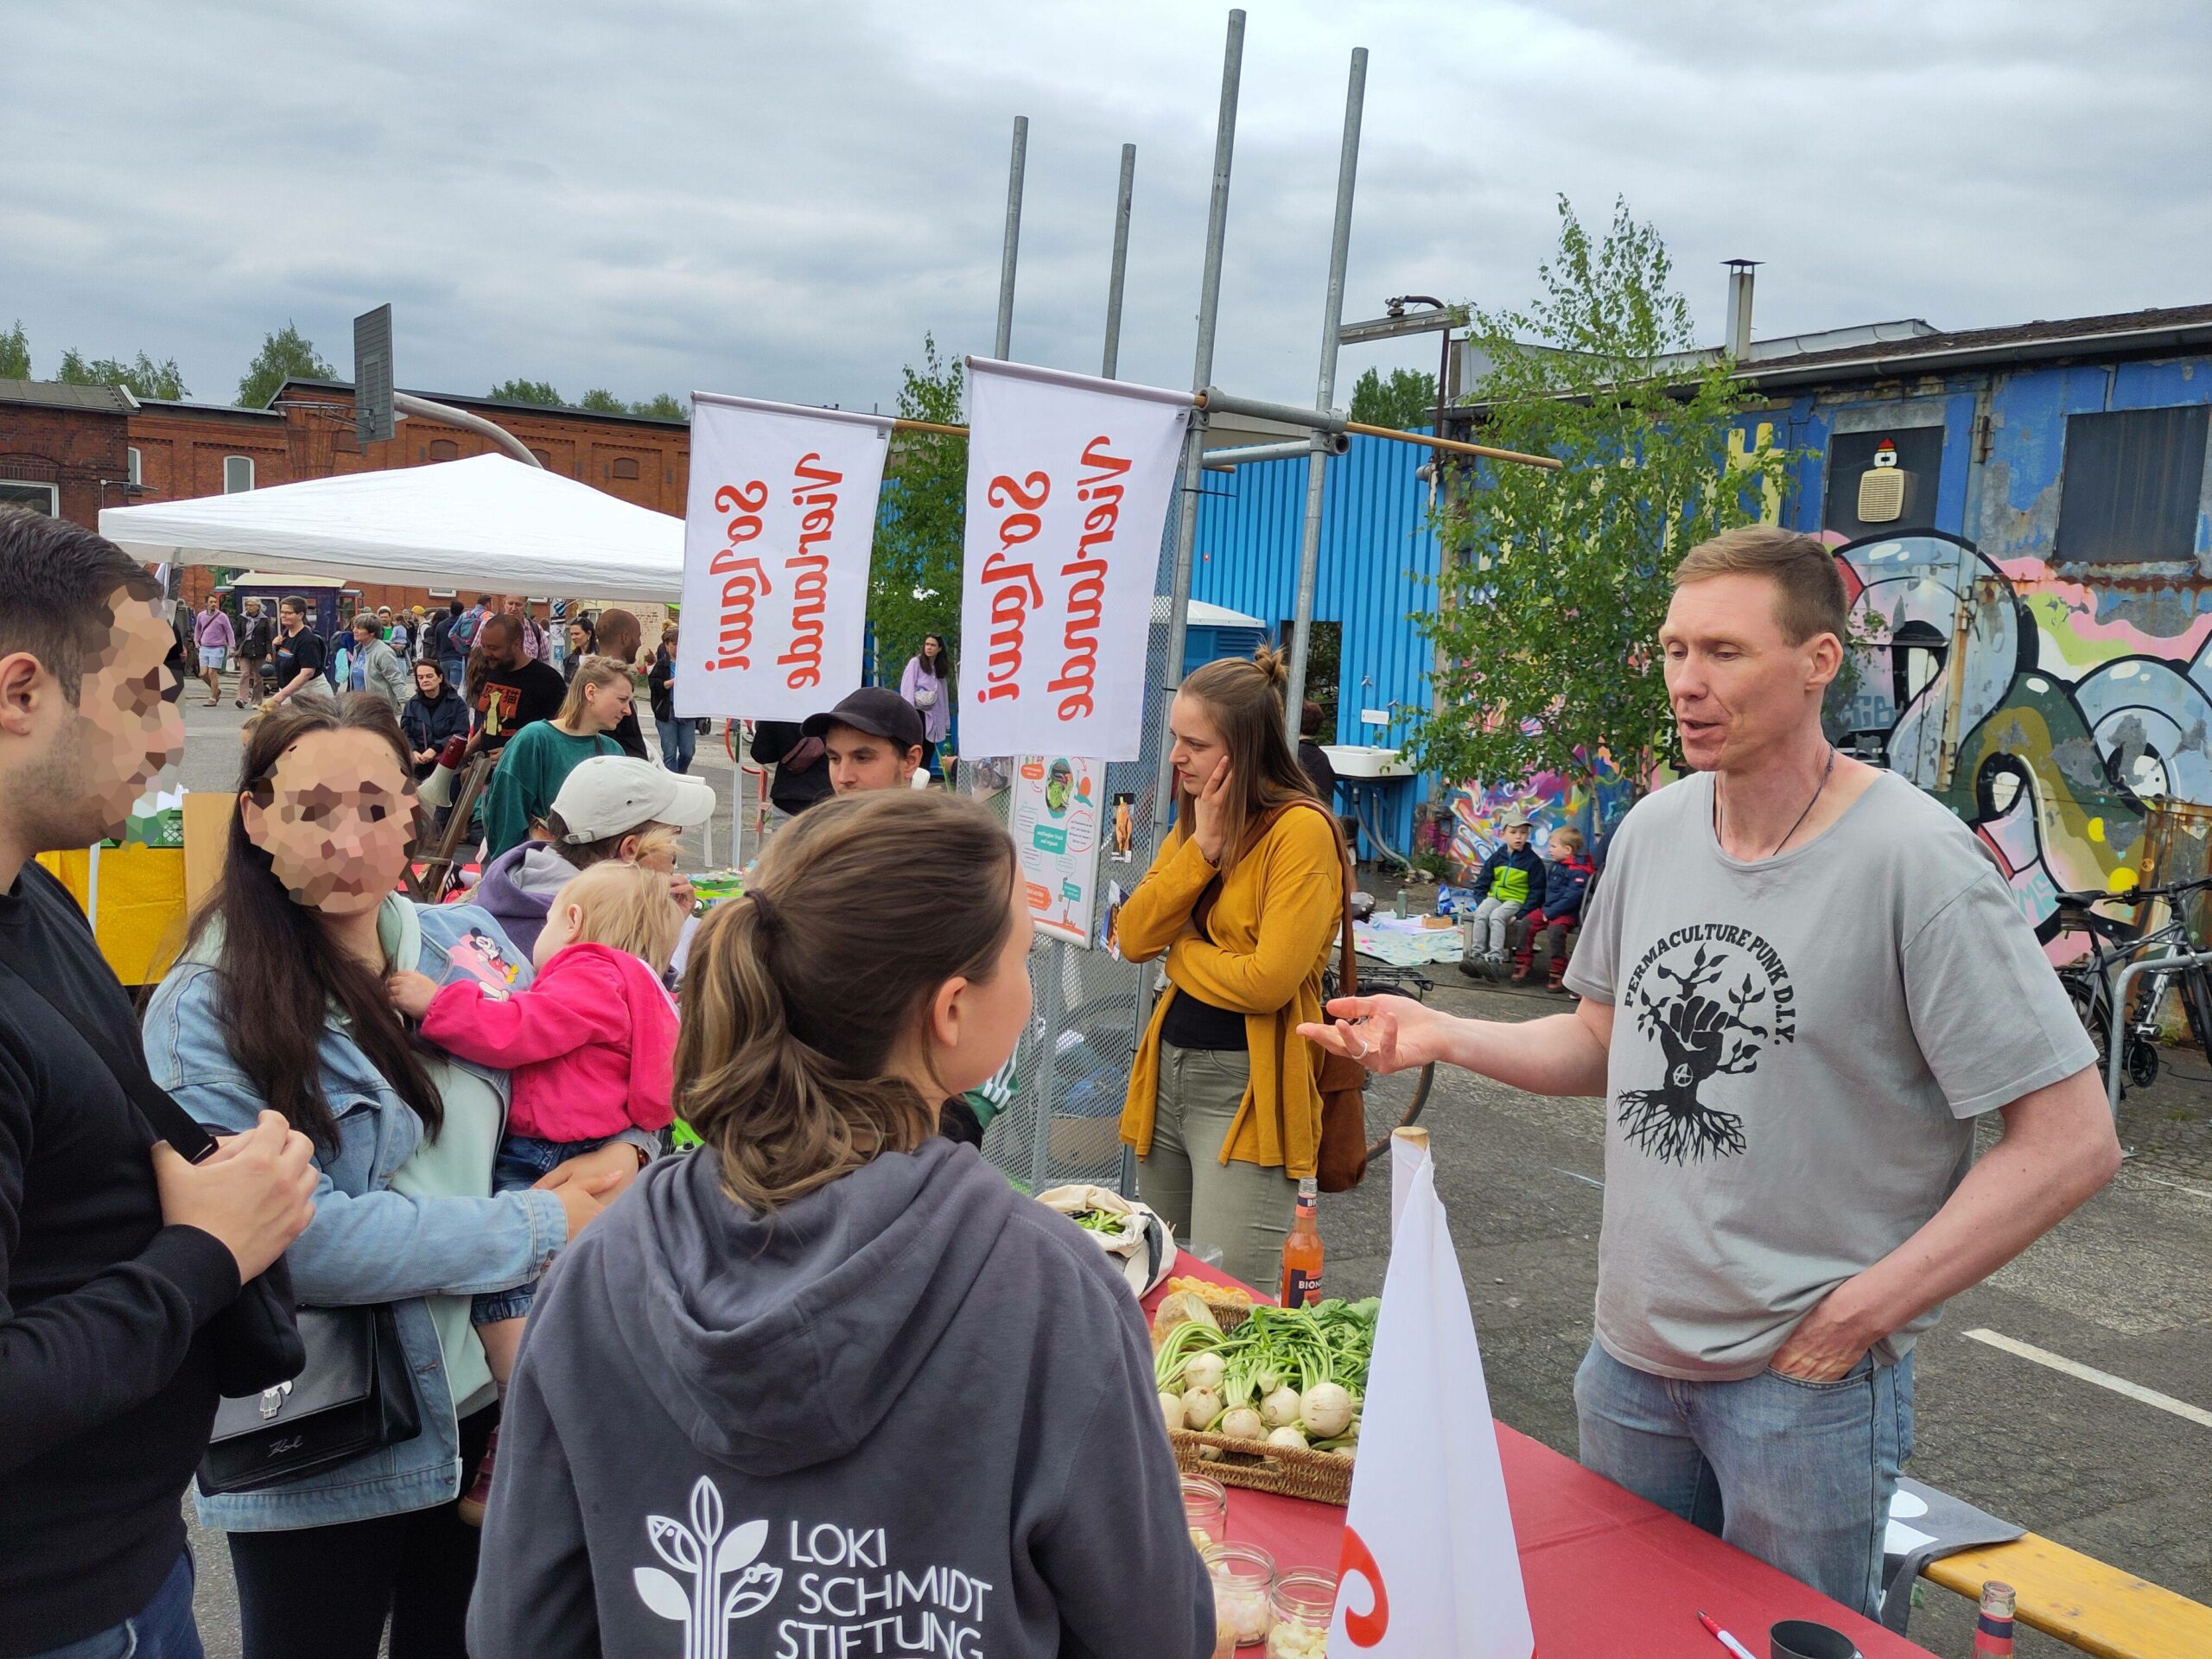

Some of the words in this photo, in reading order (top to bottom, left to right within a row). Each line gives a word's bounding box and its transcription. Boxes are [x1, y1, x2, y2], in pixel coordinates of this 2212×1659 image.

[1623, 923, 1752, 1008] PERMACULTURE
[1747, 935, 1789, 987] PUNK
[790, 1520, 887, 1568] LOKI
[798, 1565, 993, 1622] SCHMIDT
[775, 1611, 984, 1659] STIFTUNG
